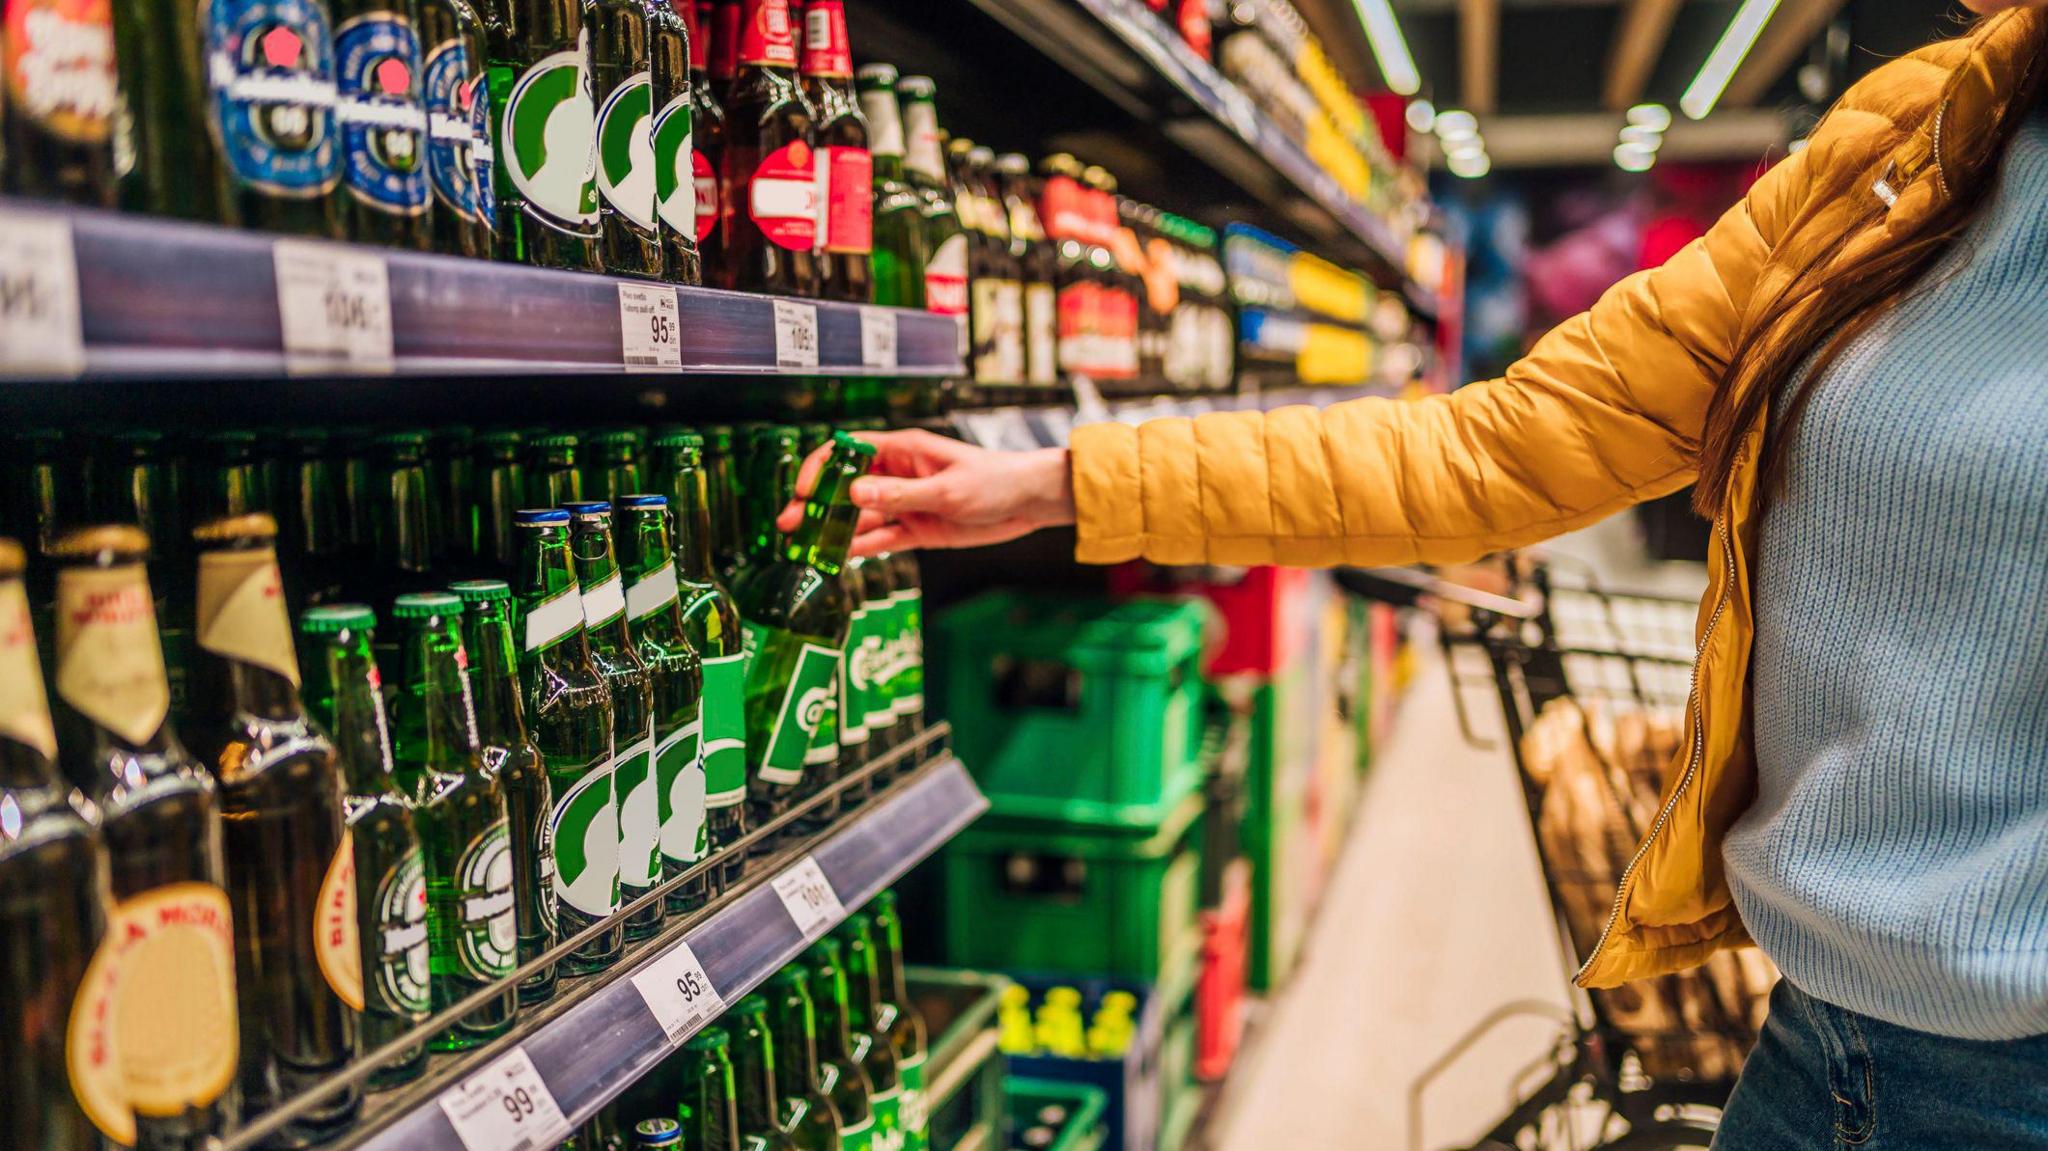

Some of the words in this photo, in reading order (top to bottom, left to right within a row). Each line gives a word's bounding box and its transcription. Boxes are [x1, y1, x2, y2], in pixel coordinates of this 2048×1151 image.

[651, 315, 668, 343] 95
[668, 322, 675, 331] 99
[677, 970, 701, 1002] 95
[503, 1087, 534, 1122] 99
